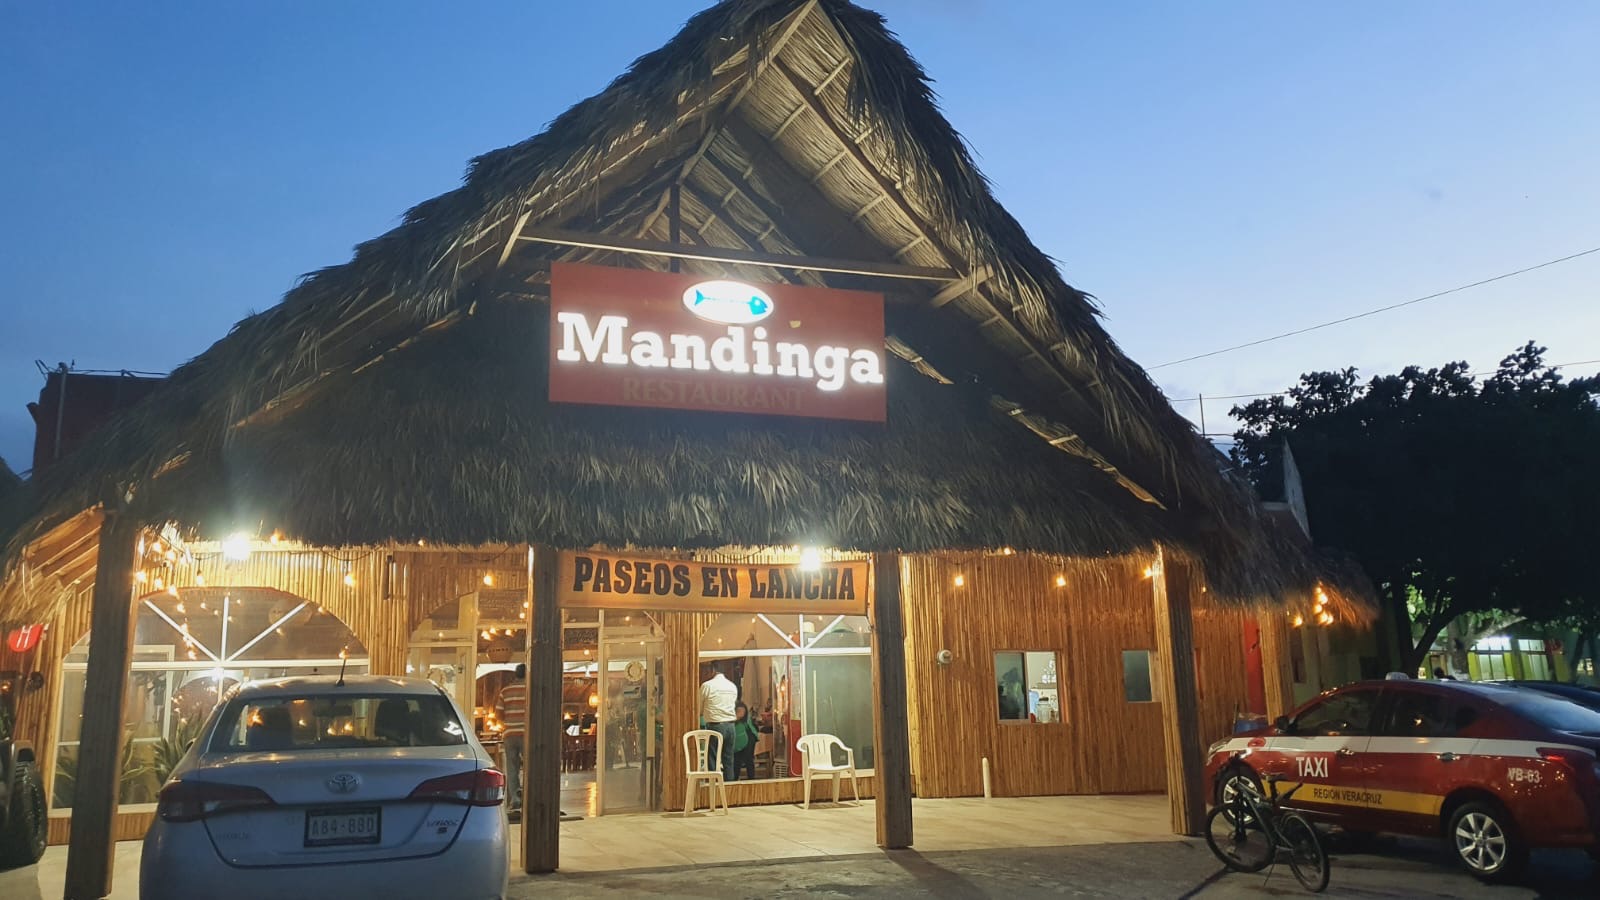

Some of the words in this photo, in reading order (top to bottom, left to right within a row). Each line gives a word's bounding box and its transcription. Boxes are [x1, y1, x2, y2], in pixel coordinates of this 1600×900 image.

[556, 312, 884, 391] Mandinga
[624, 378, 803, 410] RESTAURANT
[573, 556, 692, 597] PASEOS
[701, 567, 739, 598] EN
[749, 567, 855, 600] LANCHA
[1295, 757, 1329, 778] TAXI
[1313, 787, 1341, 801] REGION
[1341, 790, 1383, 805] VERACRUZ
